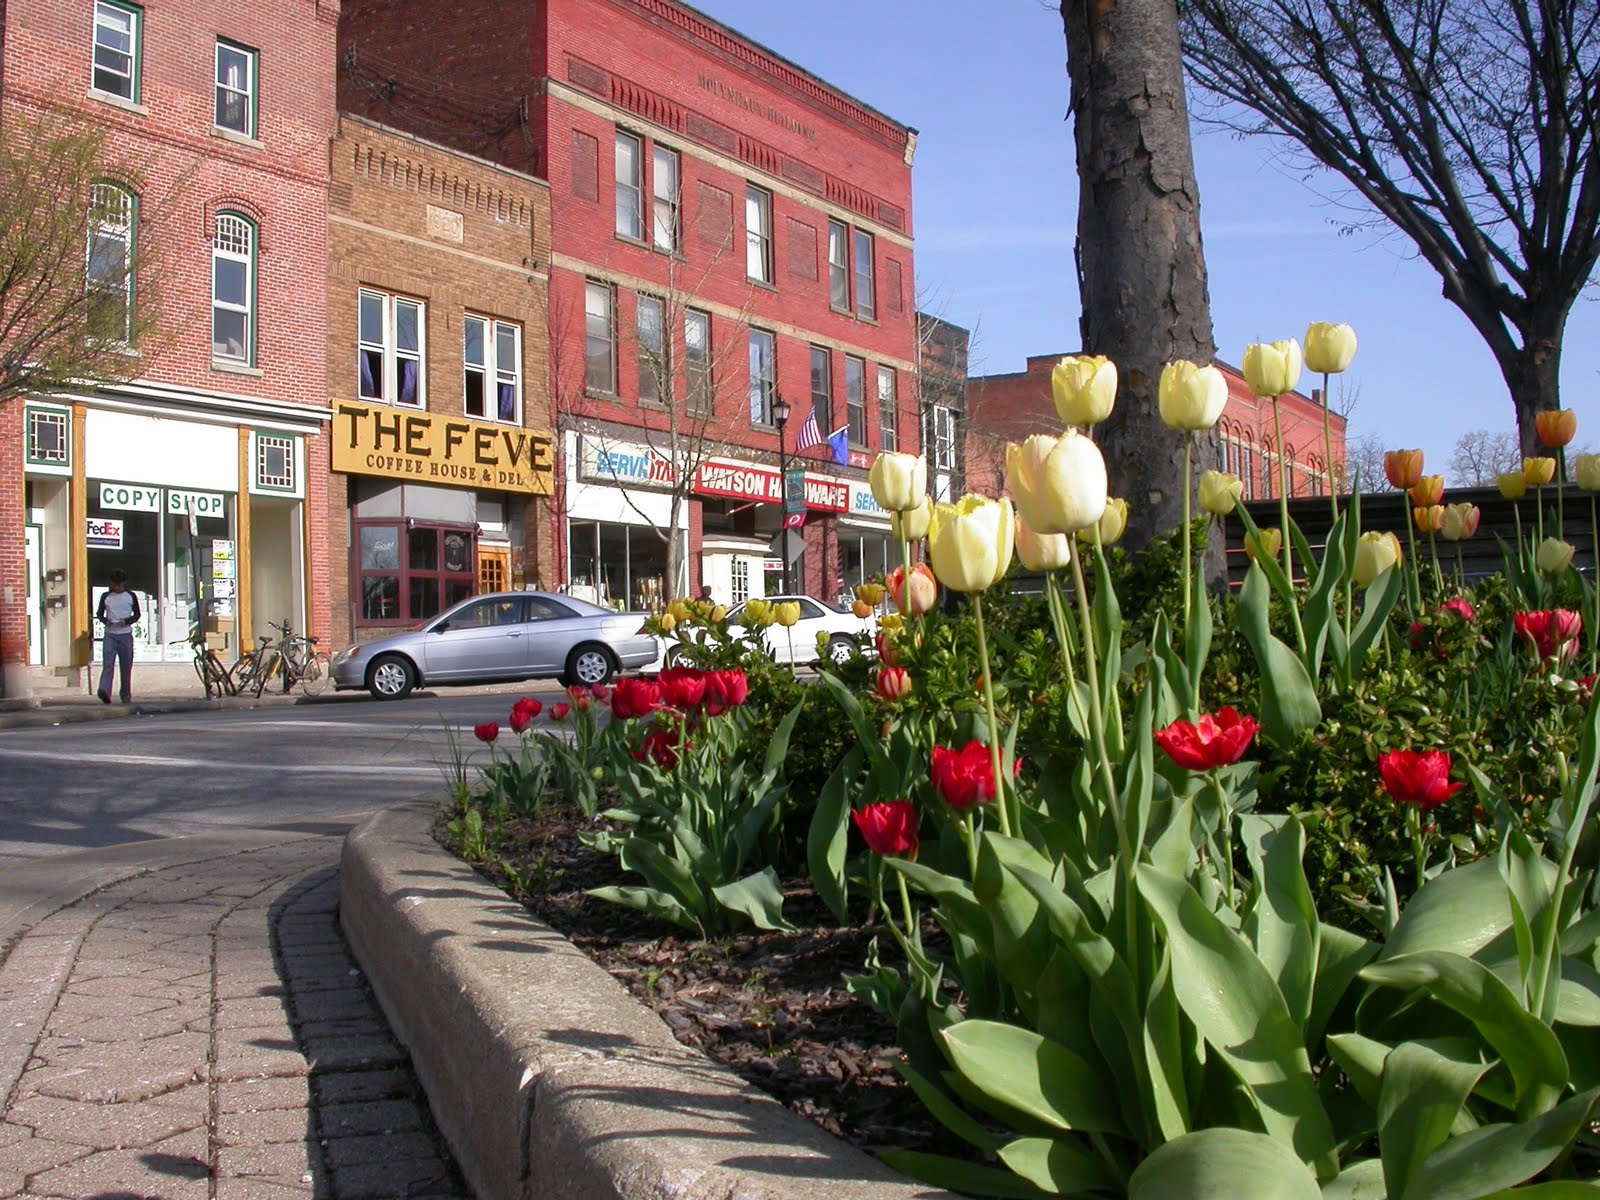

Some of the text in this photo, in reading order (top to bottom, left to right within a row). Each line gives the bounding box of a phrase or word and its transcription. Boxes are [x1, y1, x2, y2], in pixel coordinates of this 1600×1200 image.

[338, 404, 552, 473] THE FEVE
[366, 453, 531, 486] COFFEE HOUSE & DEL
[701, 465, 765, 496] WATSON
[102, 487, 221, 513] COPY SHOP
[87, 521, 120, 536] FedEx
